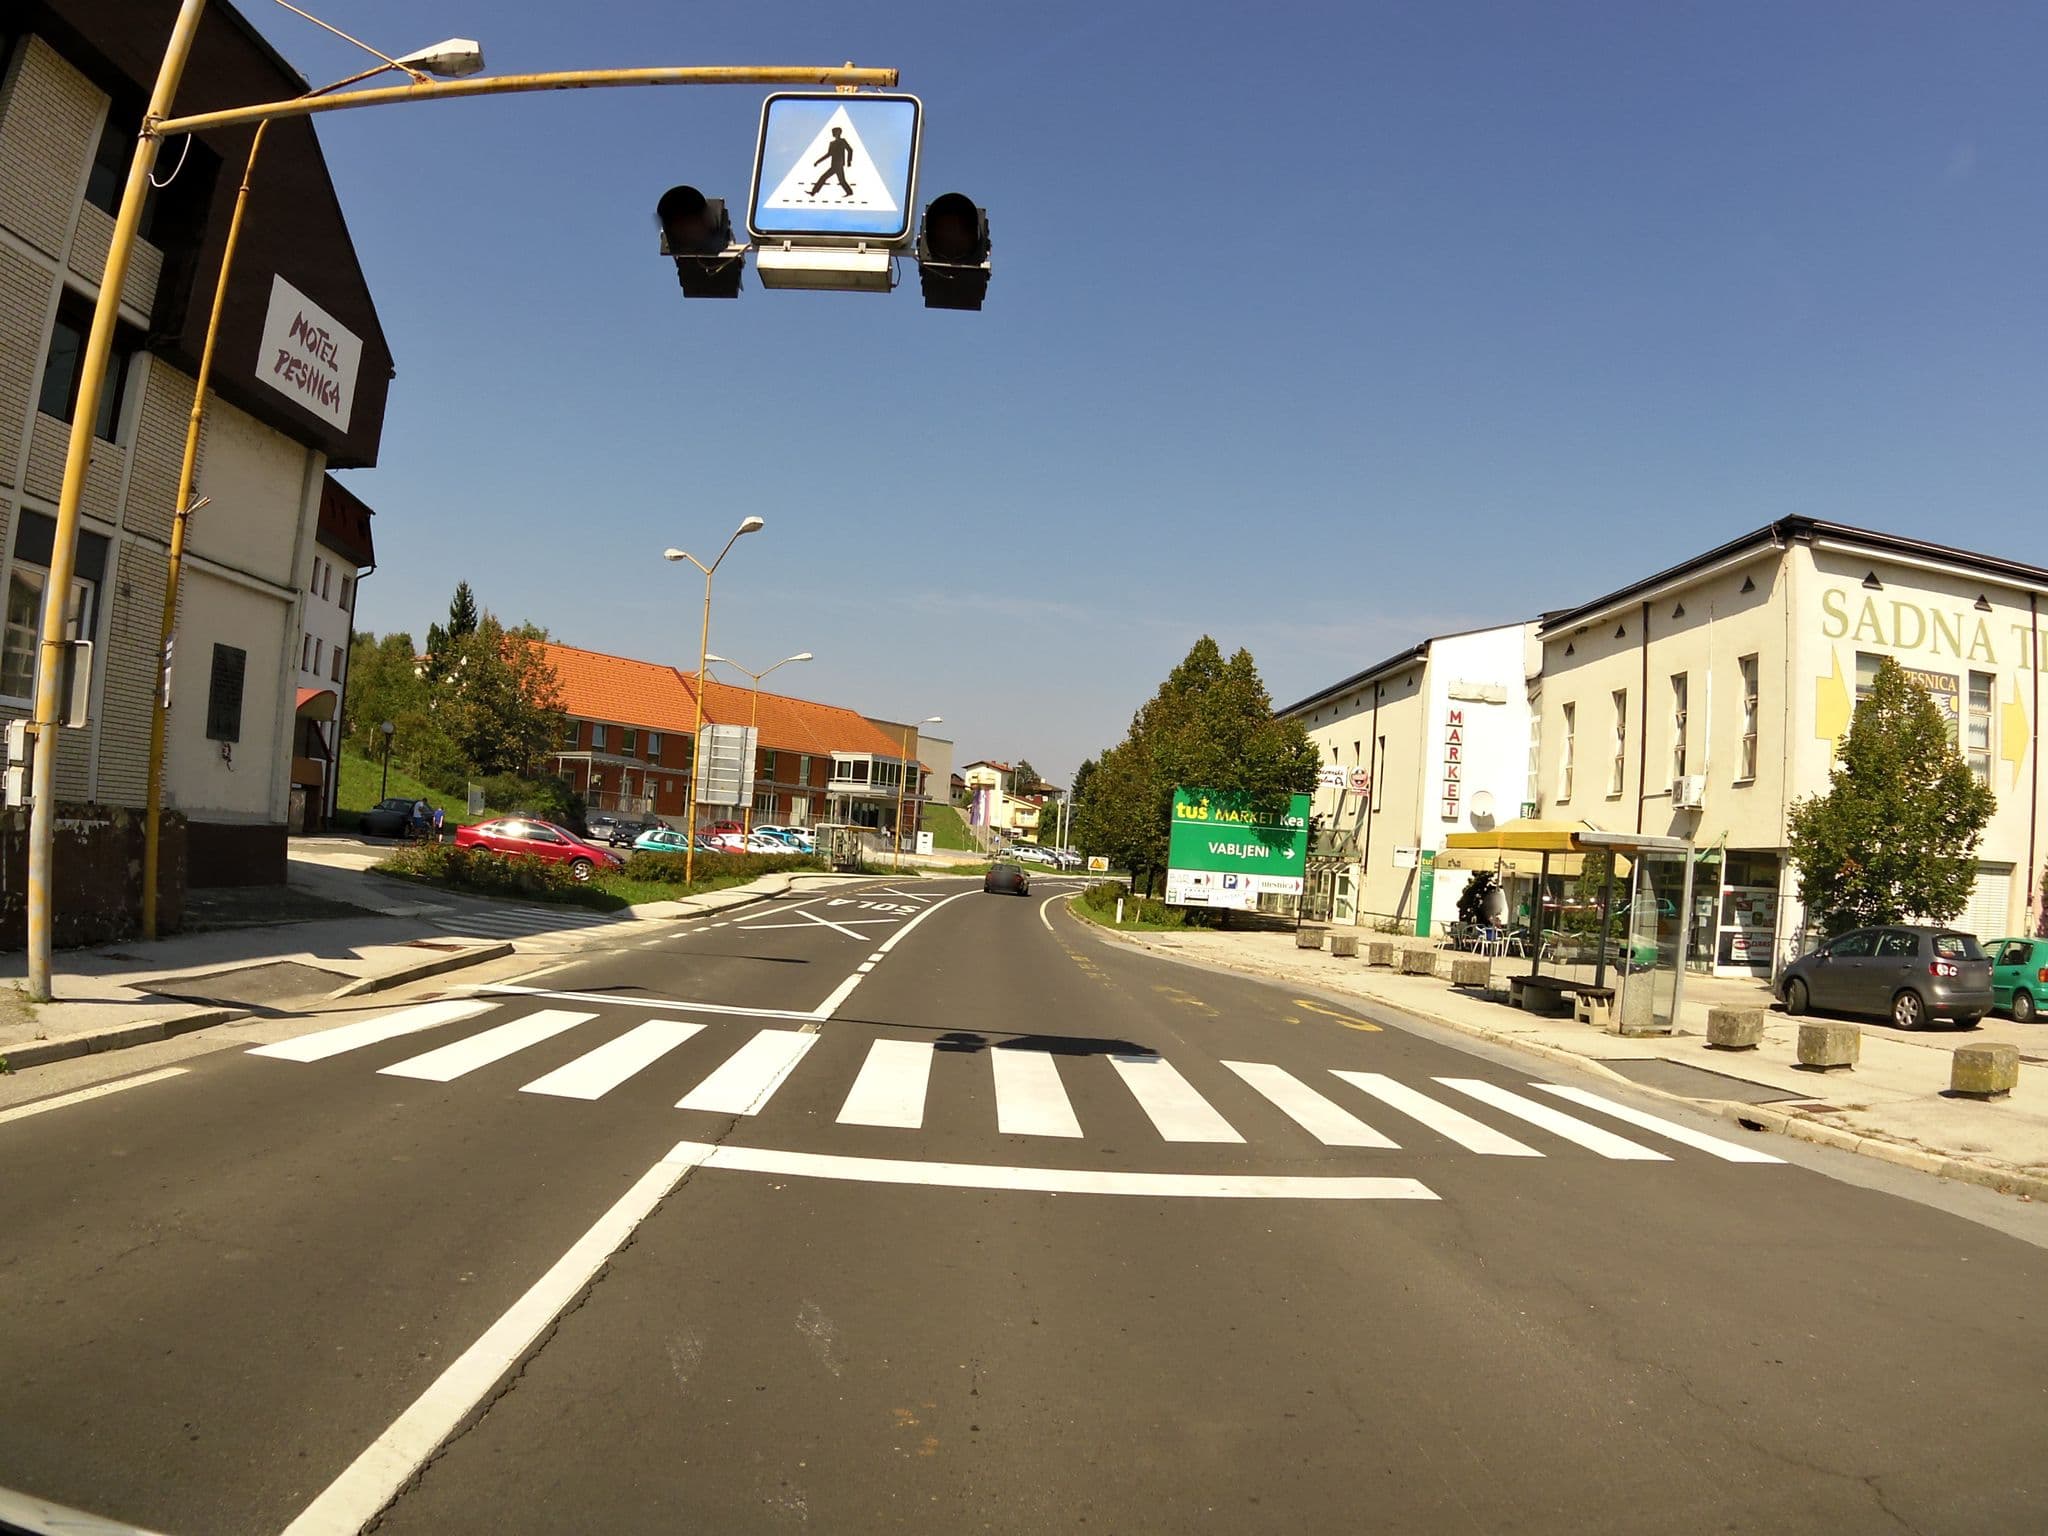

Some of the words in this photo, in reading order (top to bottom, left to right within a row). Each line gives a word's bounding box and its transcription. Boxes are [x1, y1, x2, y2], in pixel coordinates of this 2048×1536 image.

[274, 349, 339, 414] PESNICA
[1822, 588, 1997, 664] SADNA
[1446, 710, 1462, 815] MARKET
[1208, 842, 1269, 858] VABLJENI
[1215, 809, 1274, 823] MARKET
[1280, 814, 1304, 827] Kea
